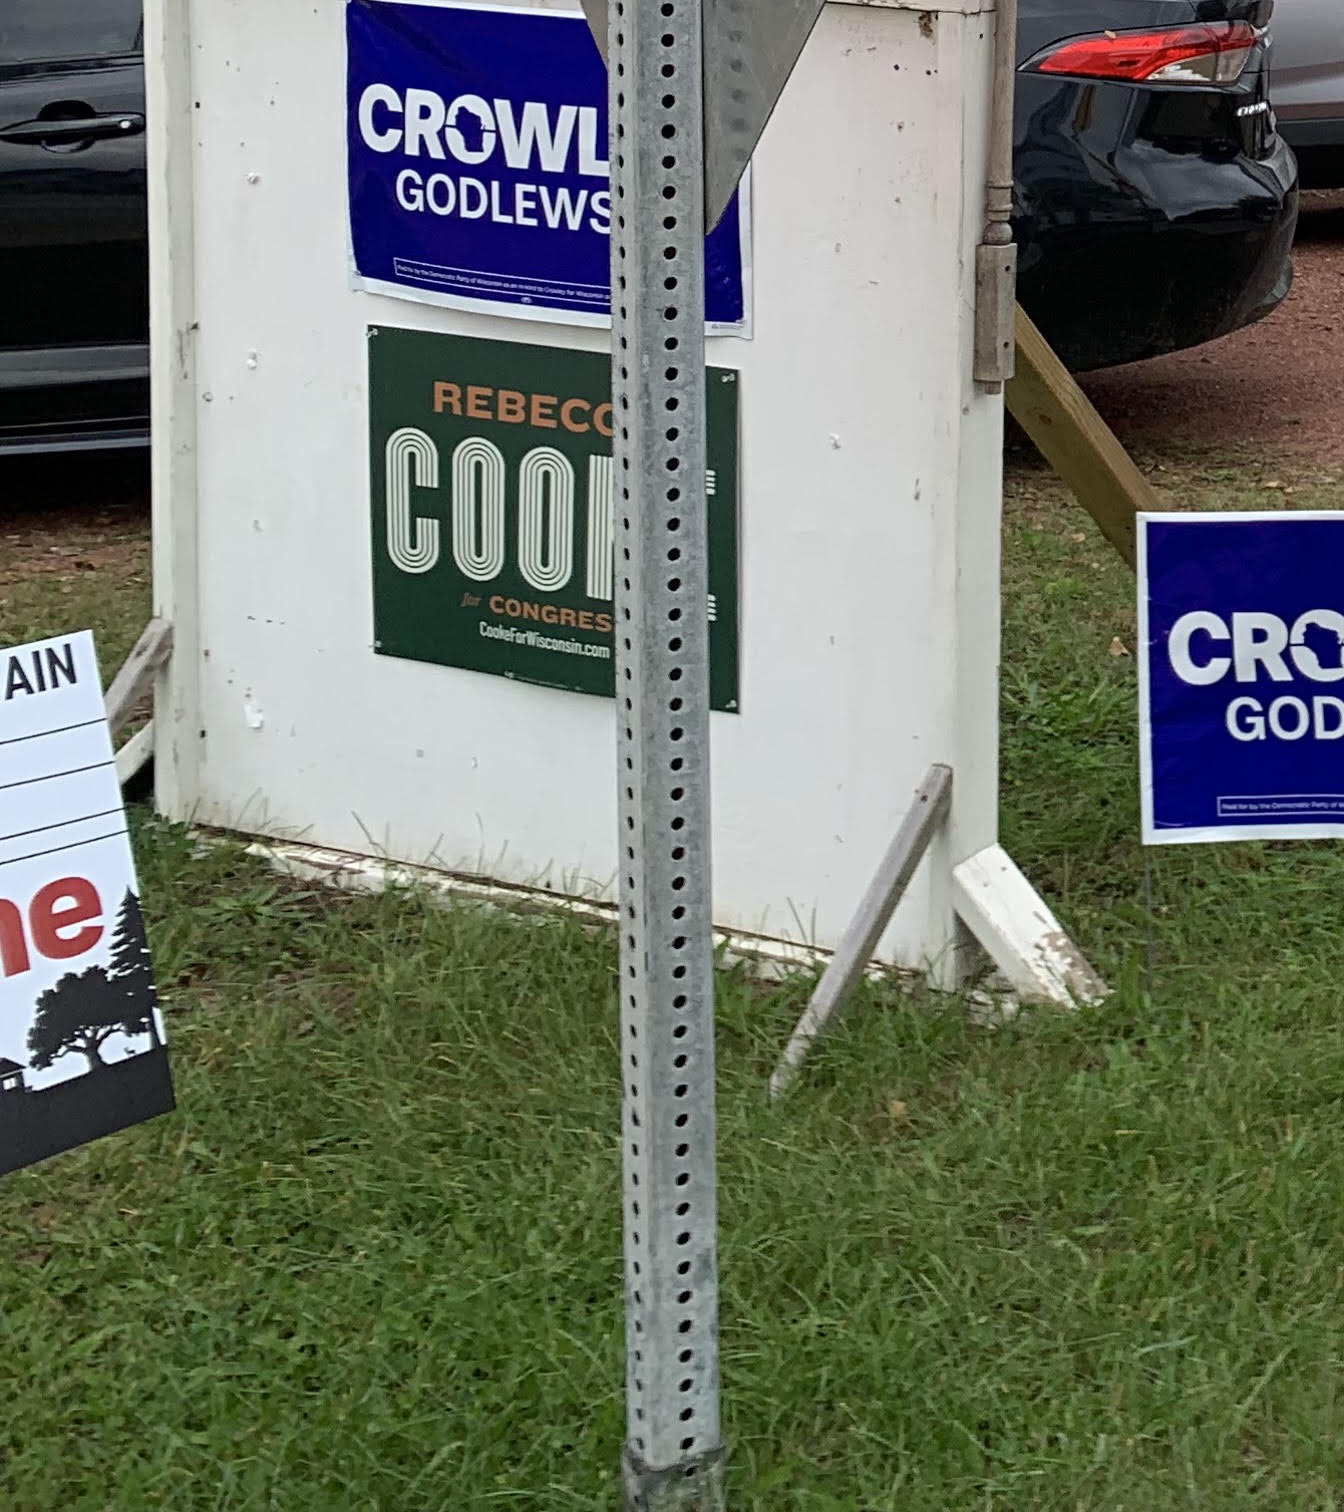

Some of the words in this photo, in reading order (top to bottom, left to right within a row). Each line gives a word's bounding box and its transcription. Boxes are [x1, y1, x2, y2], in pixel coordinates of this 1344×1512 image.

[358, 83, 610, 177] CROWL
[396, 168, 611, 234] GODLEWS
[433, 381, 613, 437] REBECC
[386, 426, 716, 622] COO
[461, 592, 482, 608] for
[489, 595, 613, 633] CONGRES
[479, 621, 611, 659] CookeForWisconsin.com
[5, 643, 77, 701] AIN
